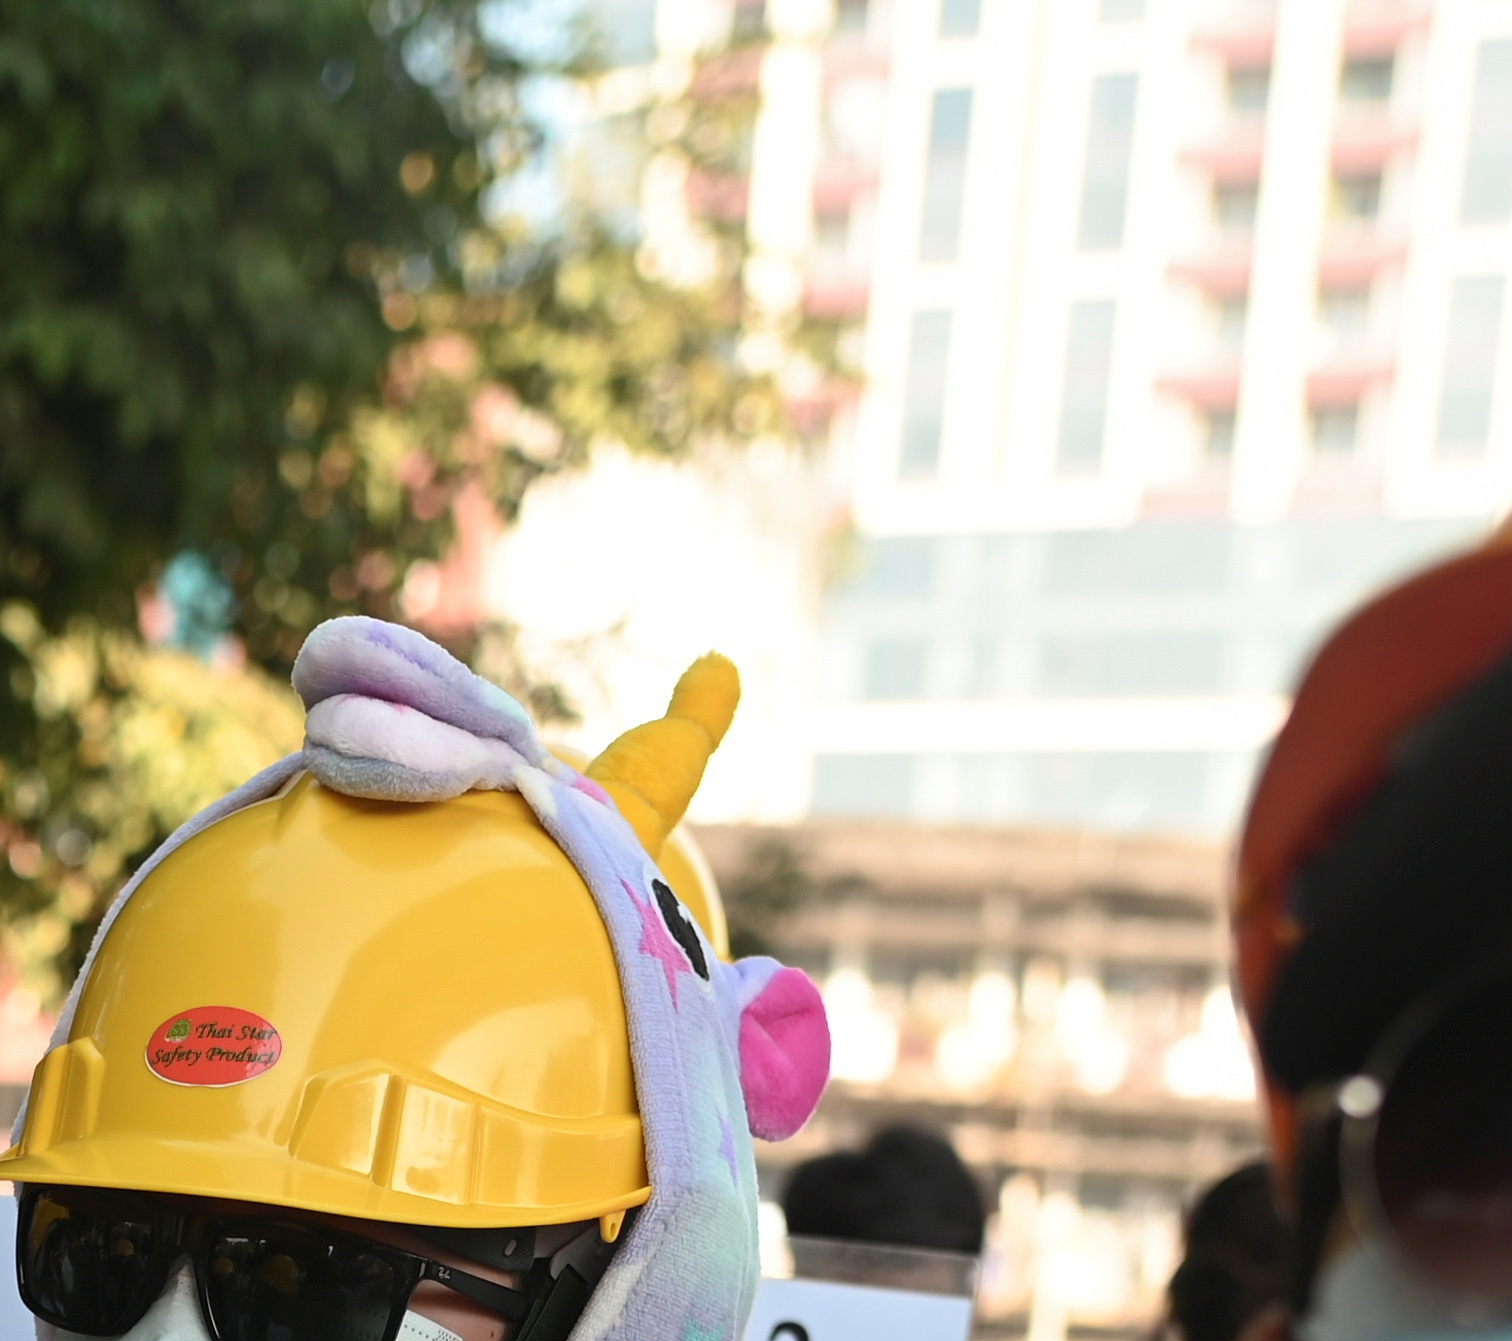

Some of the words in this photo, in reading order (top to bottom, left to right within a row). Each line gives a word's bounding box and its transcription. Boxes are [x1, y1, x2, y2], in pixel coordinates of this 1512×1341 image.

[195, 1022, 235, 1039] Thai
[235, 1025, 278, 1041] Star
[151, 1045, 202, 1068] Safety
[206, 1045, 275, 1064] Product
